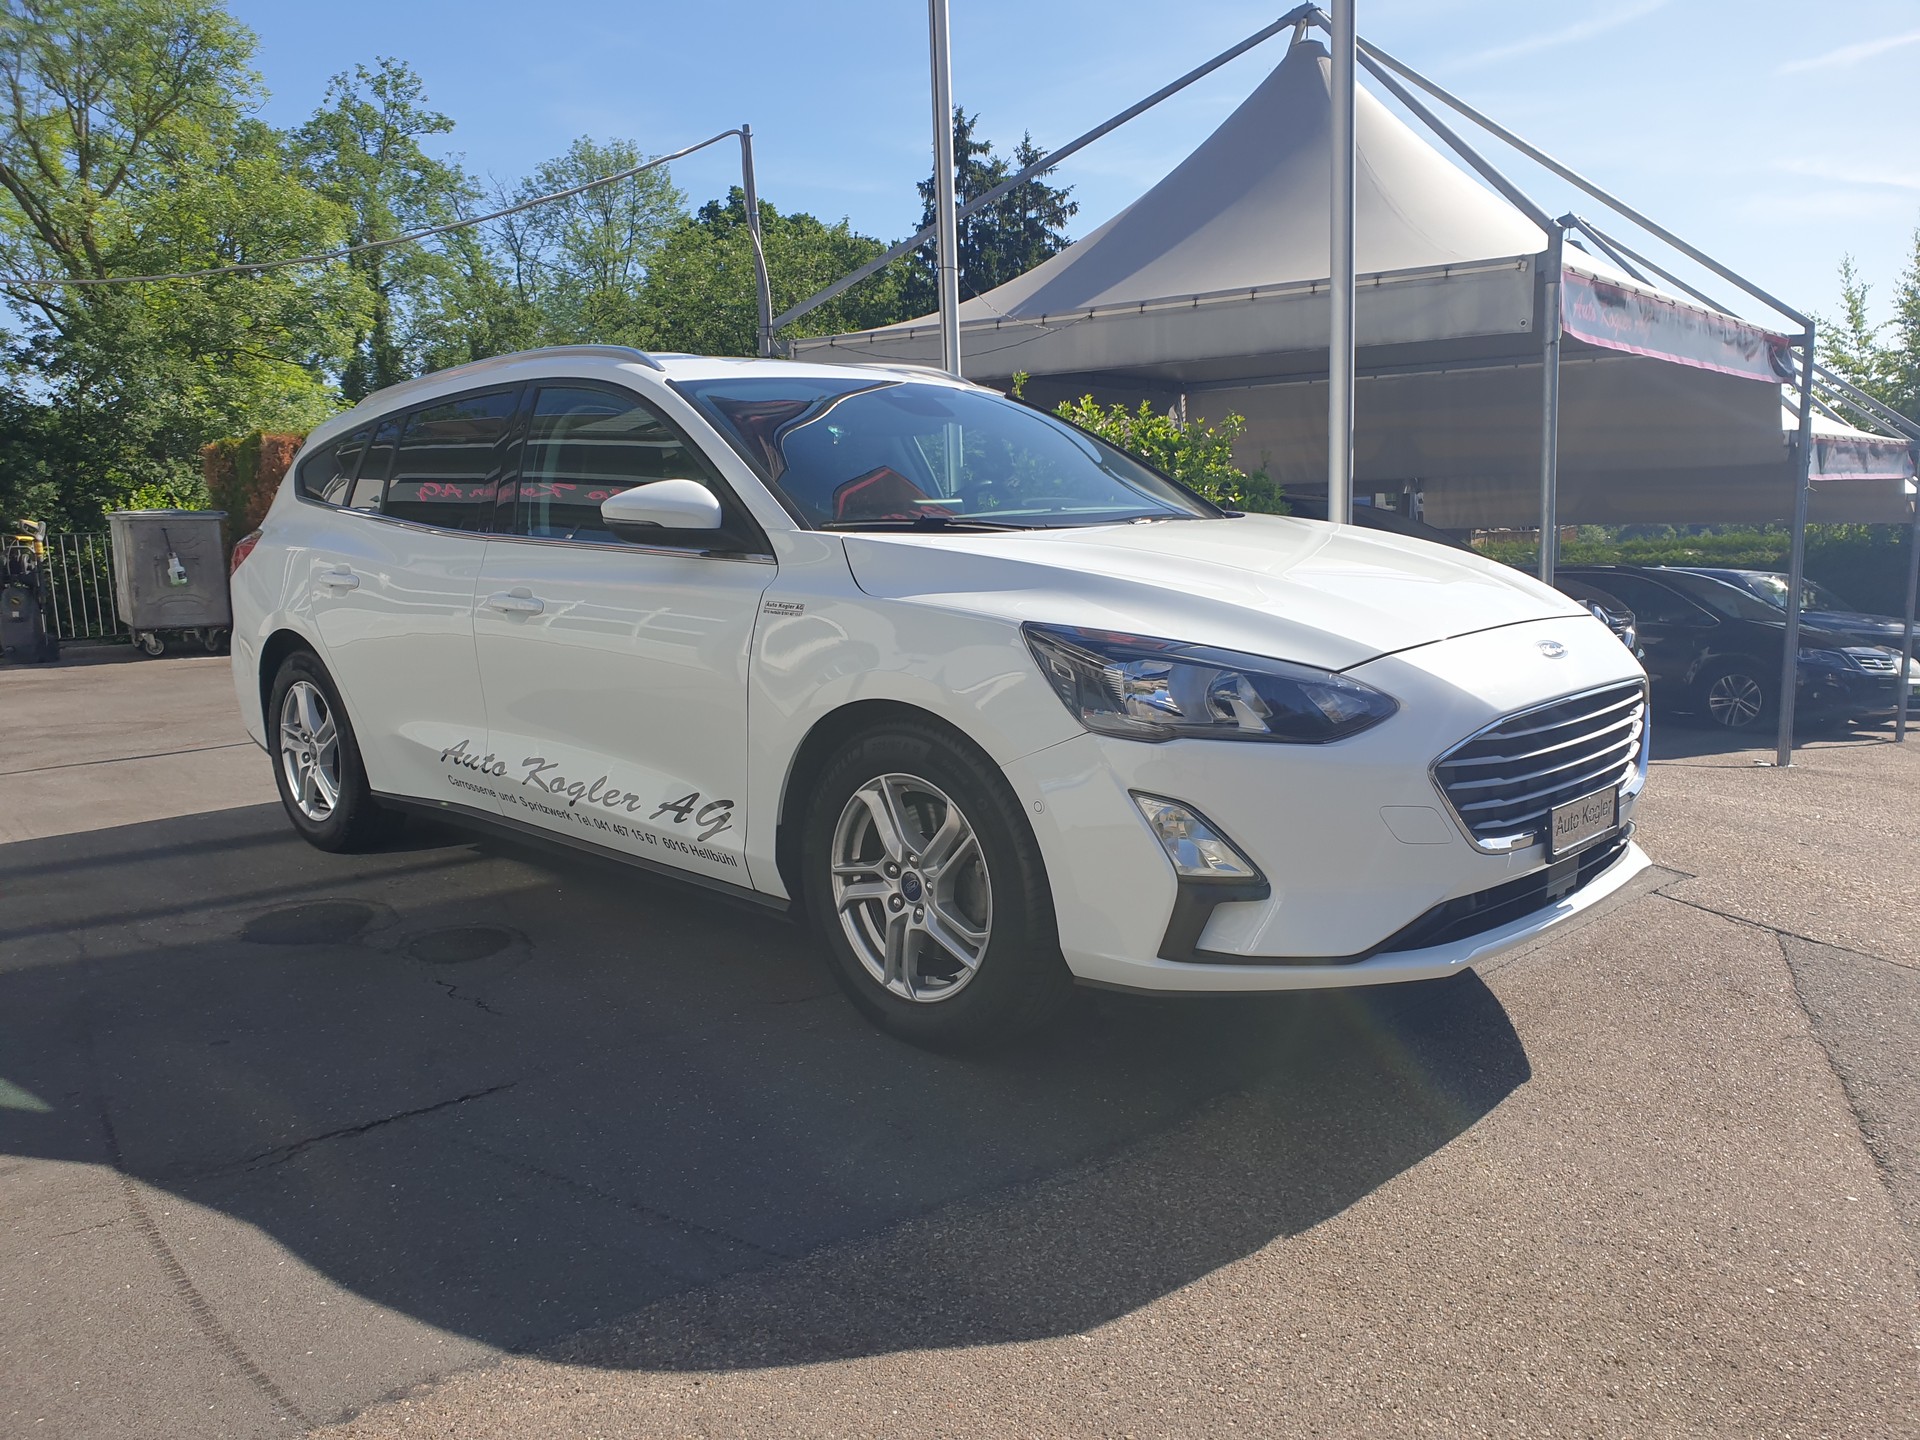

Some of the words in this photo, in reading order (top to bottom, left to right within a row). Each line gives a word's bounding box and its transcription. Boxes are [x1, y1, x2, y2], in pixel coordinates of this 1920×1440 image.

[441, 739, 507, 776] Auto
[521, 756, 641, 812] Kogler
[649, 792, 735, 842] AG
[447, 774, 497, 798] Carrosserie
[499, 791, 517, 804] und
[518, 796, 573, 820] Spritzwerk
[574, 812, 594, 827] Tel.
[594, 819, 611, 832] 041
[613, 823, 629, 837] 467
[631, 829, 645, 842] 15
[646, 833, 658, 846] 67
[662, 837, 689, 854] 6016
[688, 844, 738, 868] Hellbühl
[1555, 812, 1580, 837] Auto
[1581, 799, 1613, 825] Kogler
